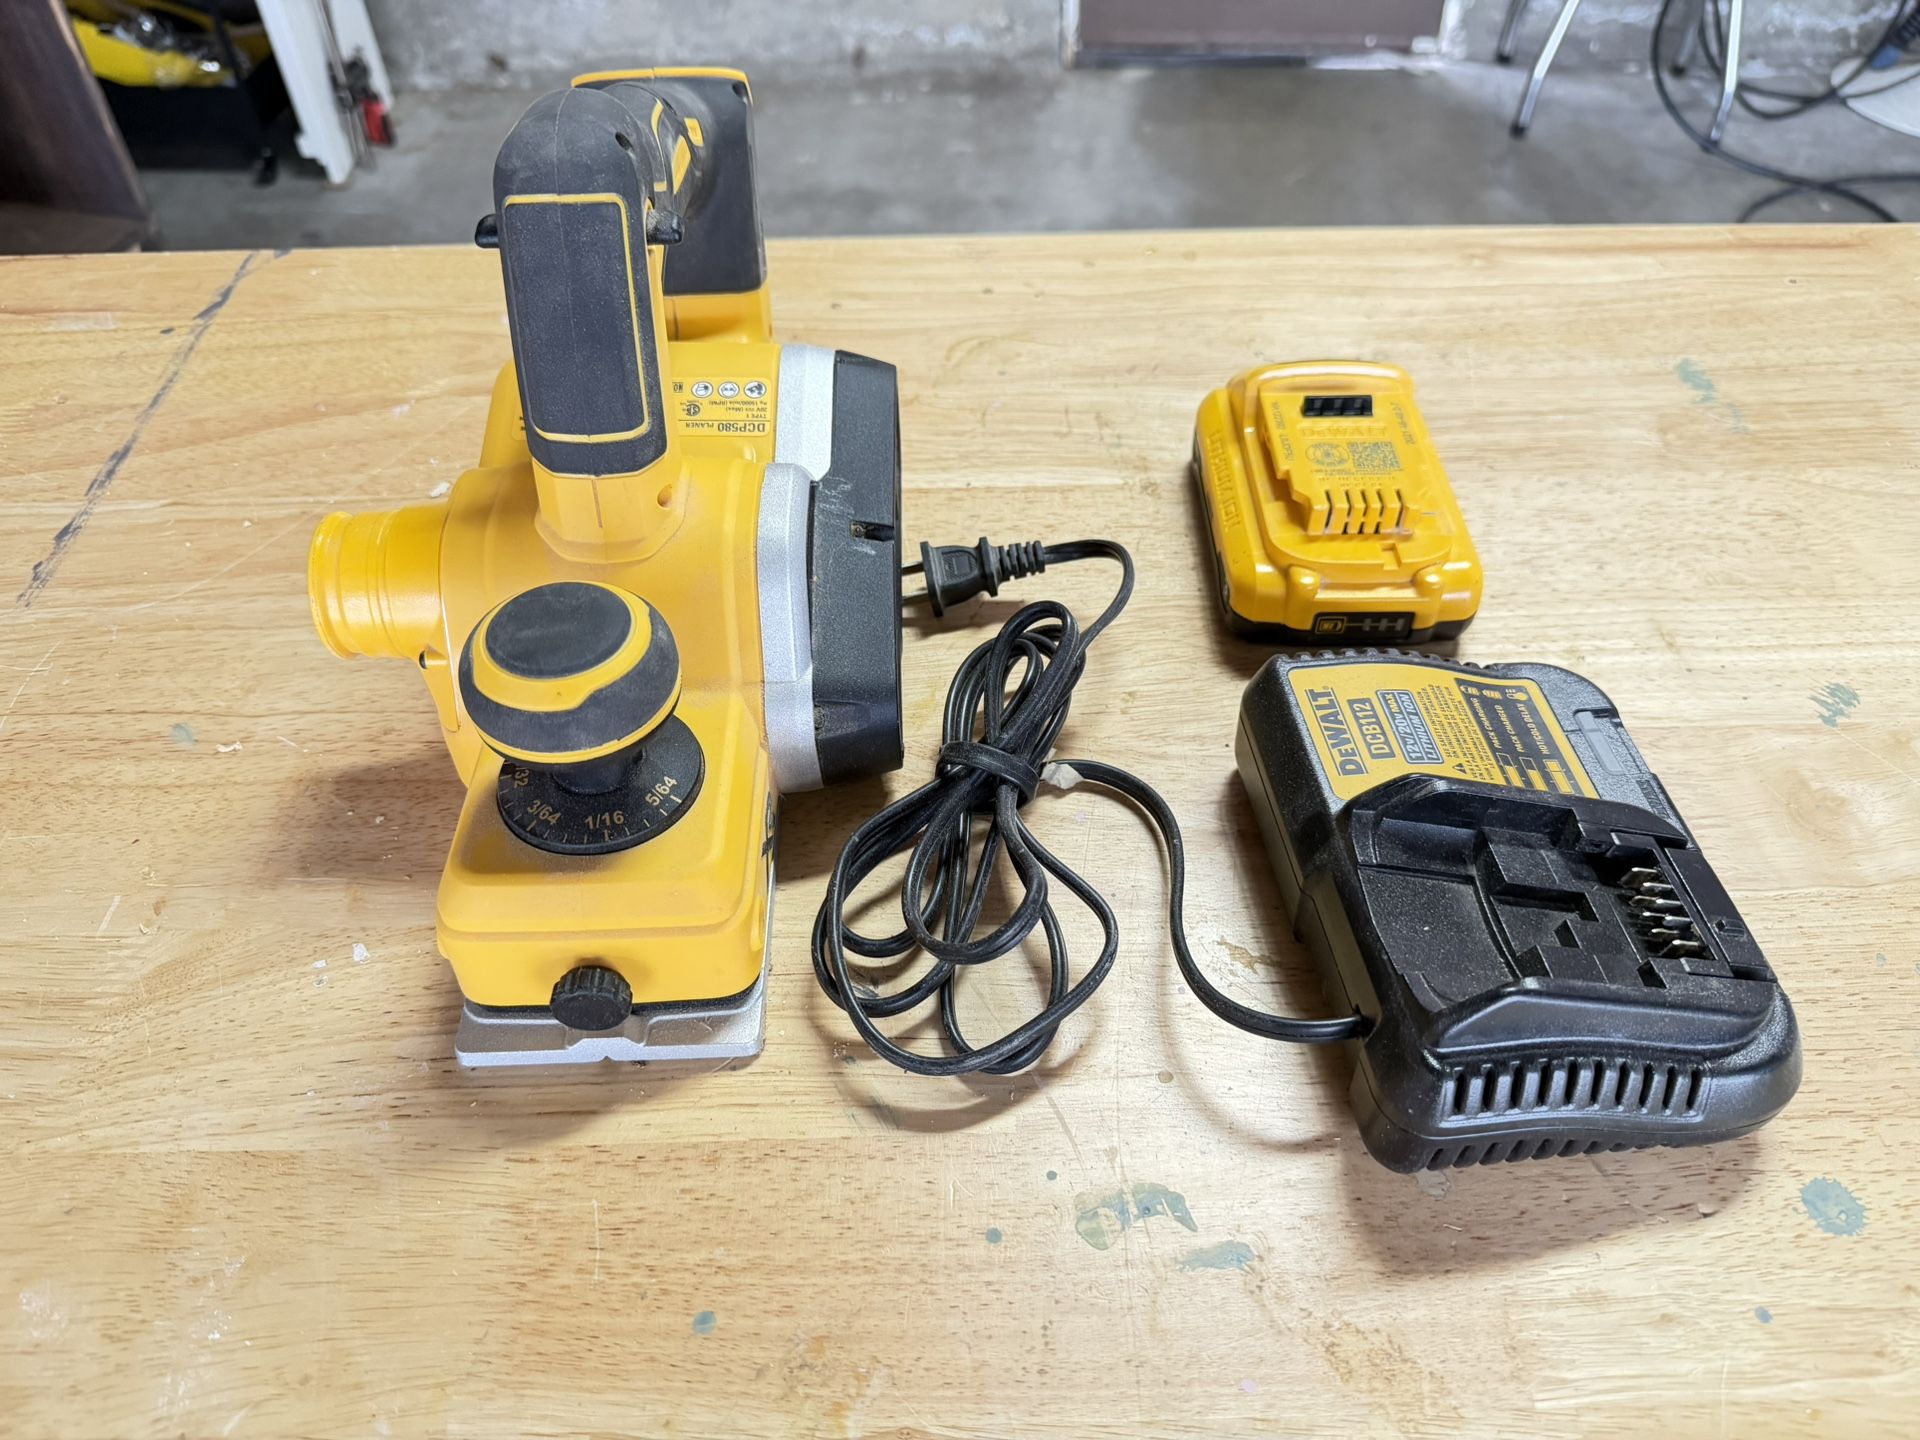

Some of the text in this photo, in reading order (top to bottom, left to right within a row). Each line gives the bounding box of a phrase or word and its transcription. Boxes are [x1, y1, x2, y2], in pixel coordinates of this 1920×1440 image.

[717, 422, 766, 433] DCP580
[1384, 693, 1399, 712] MAX
[1427, 684, 1446, 712] SEGURIDAD
[1353, 702, 1391, 755] DCB112
[1402, 693, 1438, 760] LITHIUM ION
[1415, 691, 1452, 757] SEE SAFETY INFORMATION
[1435, 718, 1455, 748] UNDERSIDE
[1452, 721, 1469, 745] INFERIOR
[1469, 697, 1502, 748] PACK CHARGING
[1493, 704, 1525, 752] PACK CHARGED
[1514, 702, 1550, 754] HOT/COLD DELAY
[1464, 746, 1478, 762] PARTE
[1469, 768, 1479, 778] VER
[645, 775, 677, 806] 5/64
[527, 799, 561, 825] 3/64
[584, 810, 625, 830] 1/16
